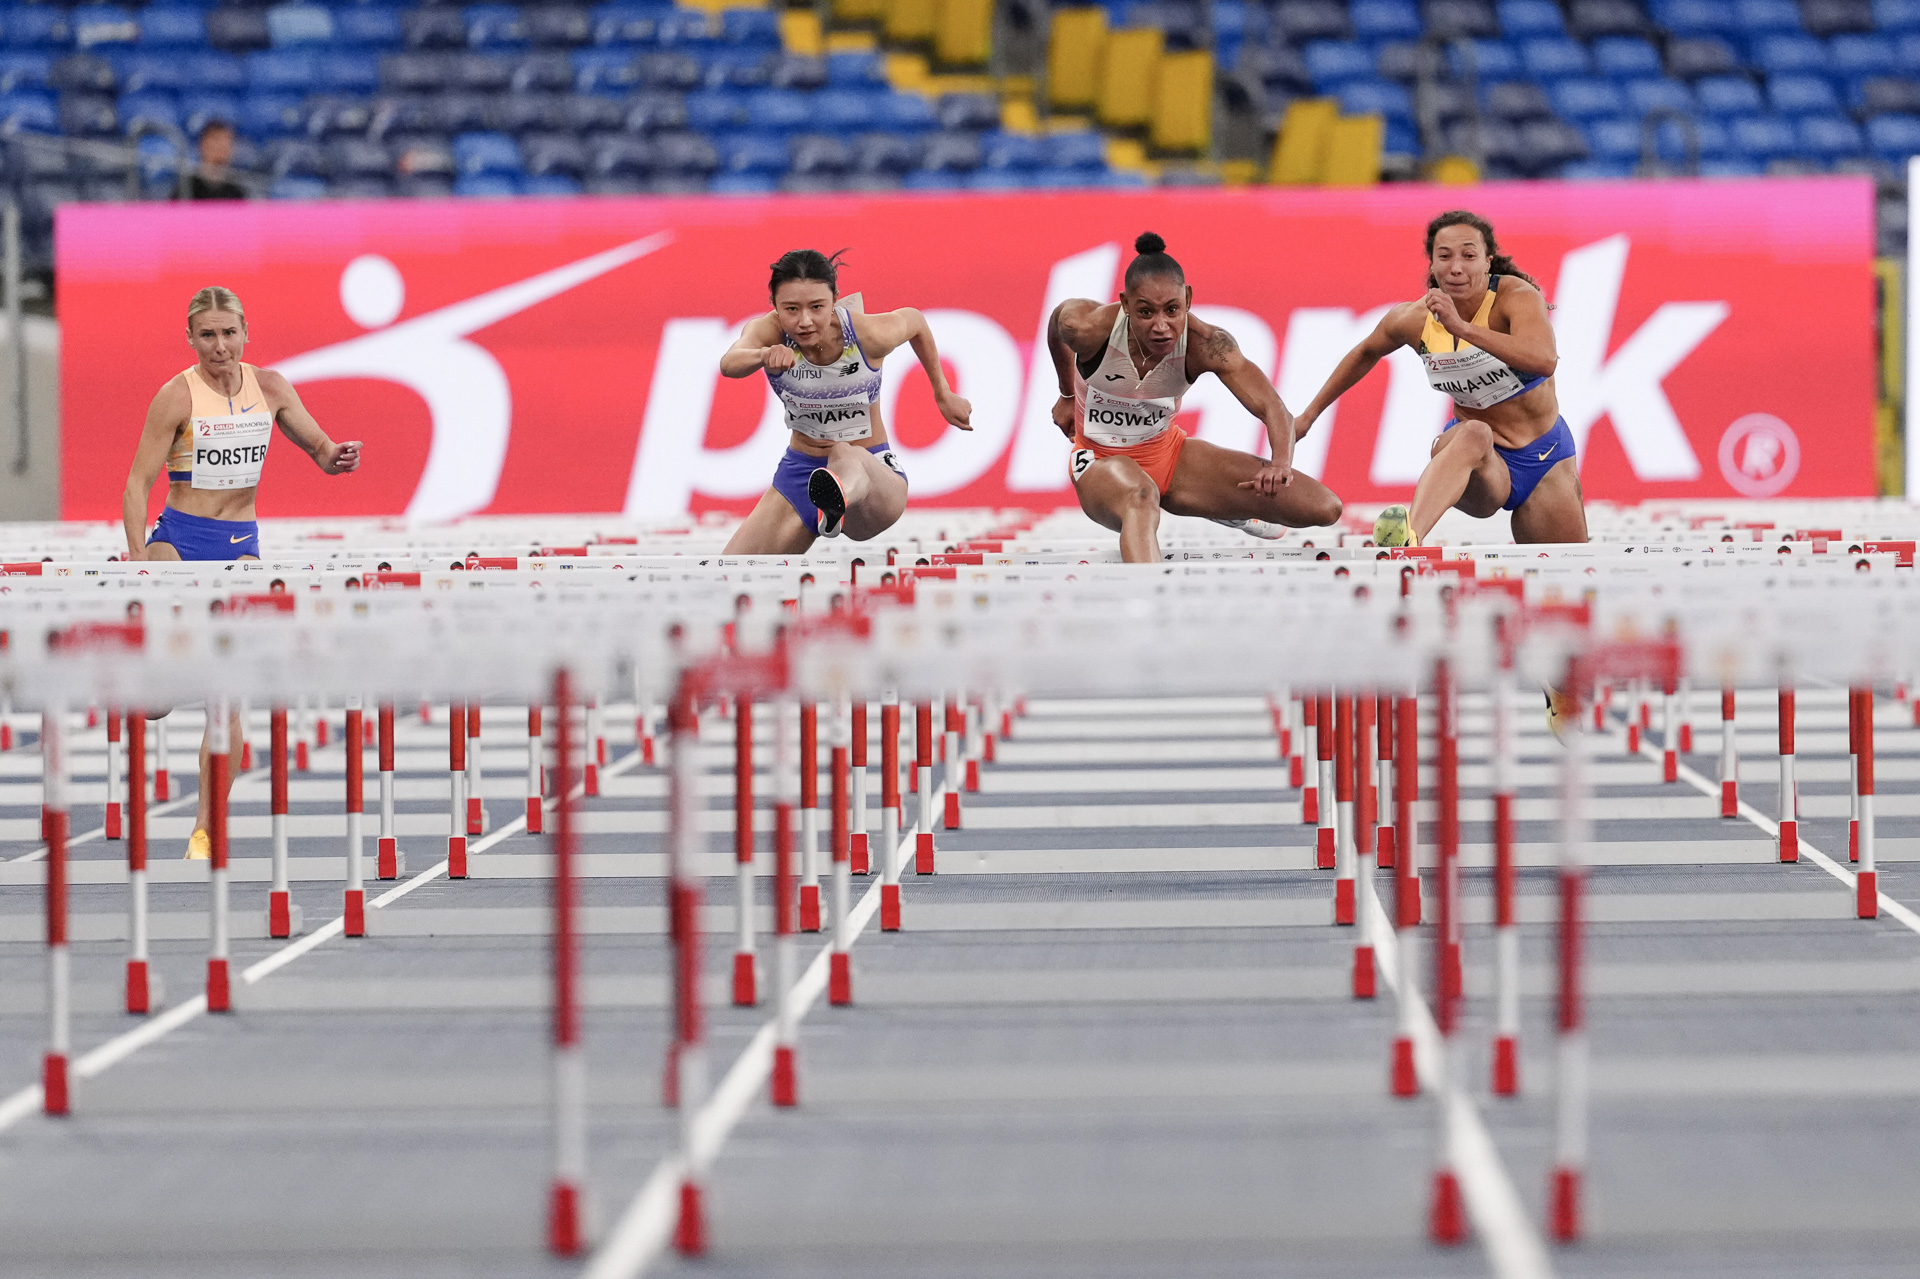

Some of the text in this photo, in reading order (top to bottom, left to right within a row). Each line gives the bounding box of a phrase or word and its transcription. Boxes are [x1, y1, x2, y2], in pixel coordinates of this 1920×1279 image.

[620, 232, 1730, 516] polank
[197, 445, 267, 465] FORSTER
[1076, 450, 1089, 472] 5
